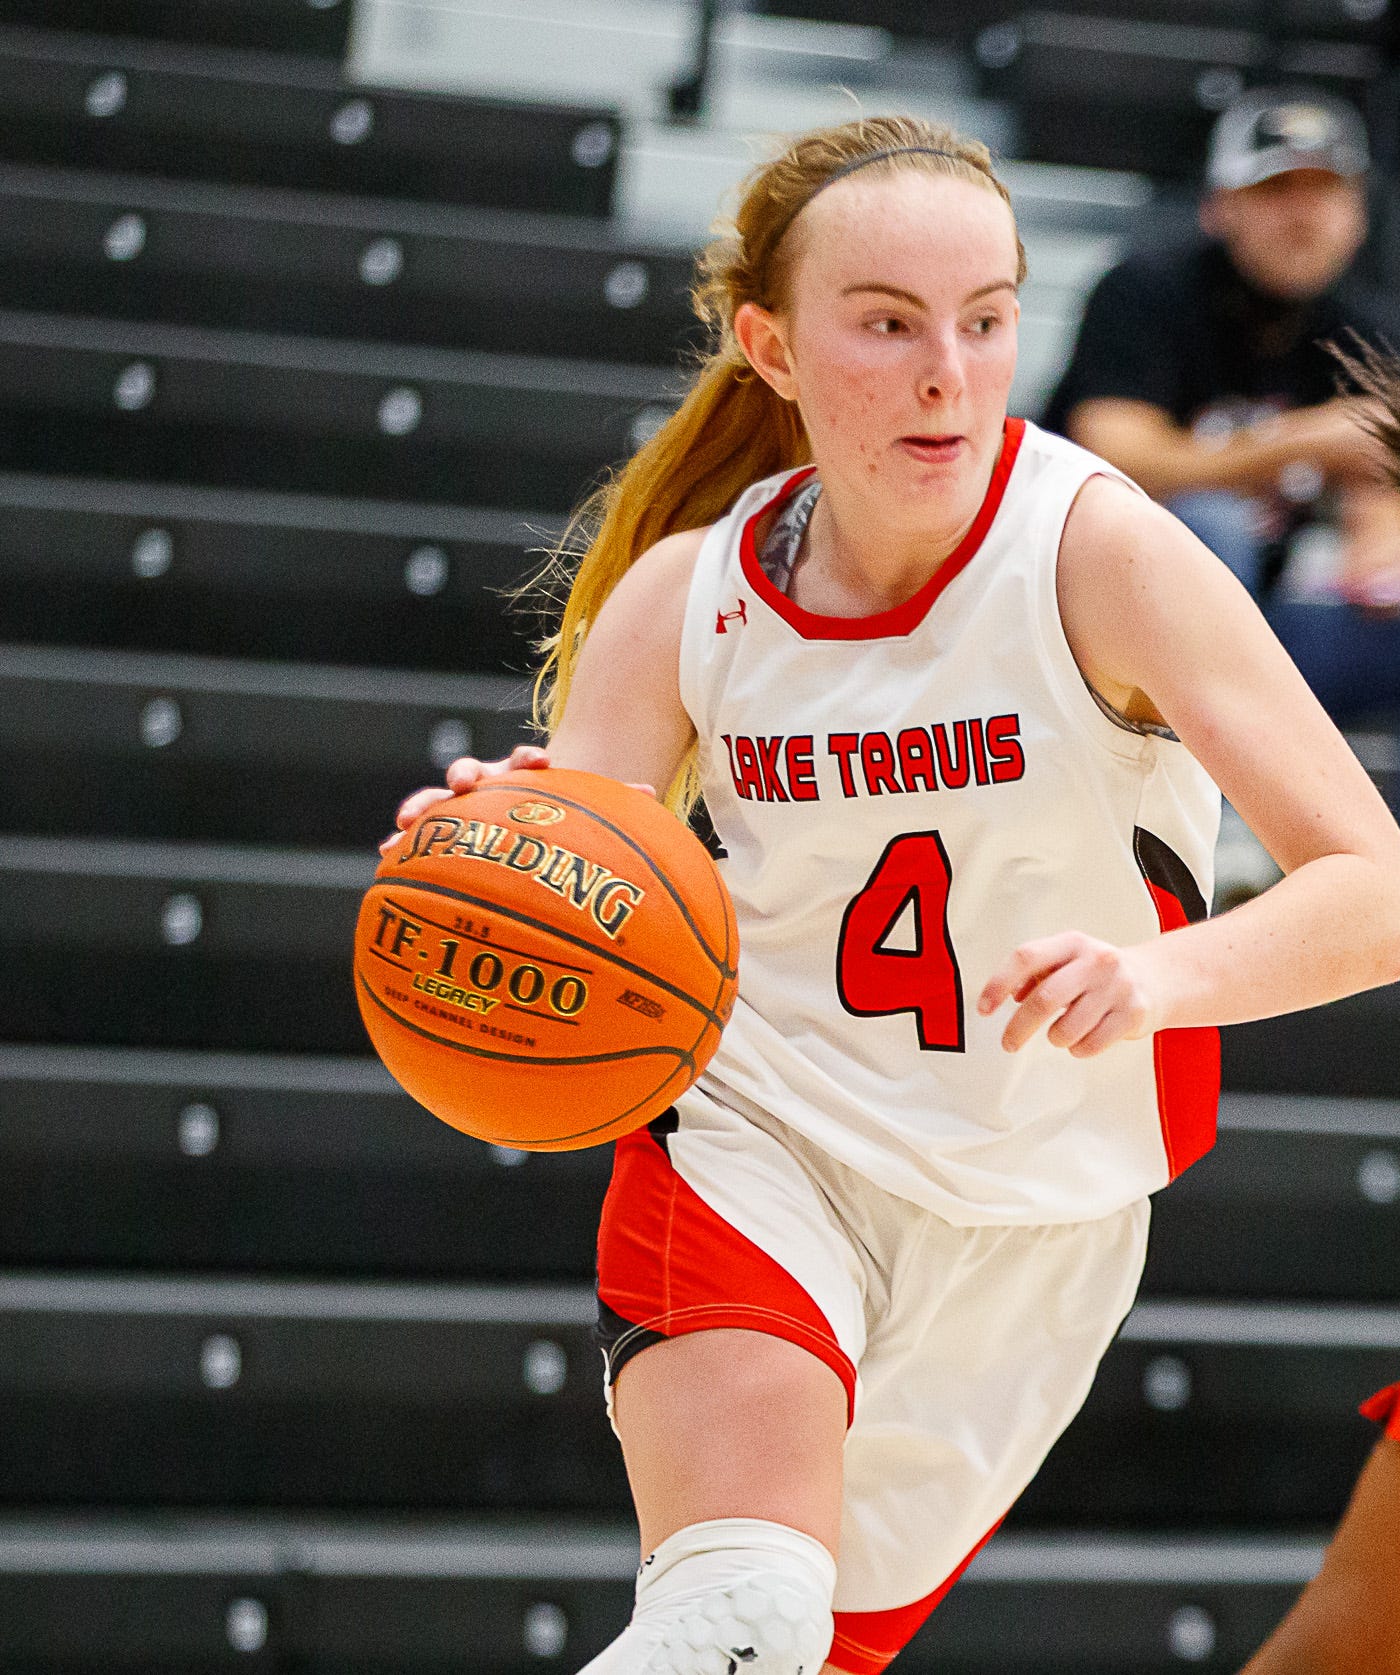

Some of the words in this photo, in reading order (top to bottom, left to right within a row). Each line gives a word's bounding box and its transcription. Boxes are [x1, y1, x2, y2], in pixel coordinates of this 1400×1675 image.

[720, 733, 821, 803] LAKE
[828, 713, 1026, 799] TRAVIS
[399, 815, 646, 941] SPALDING
[374, 906, 588, 1018] TF-1000
[836, 829, 966, 1054] 4
[411, 973, 501, 1016] LEGACY
[414, 998, 473, 1030] CHANNEL
[479, 1022, 537, 1048] DESIGN
